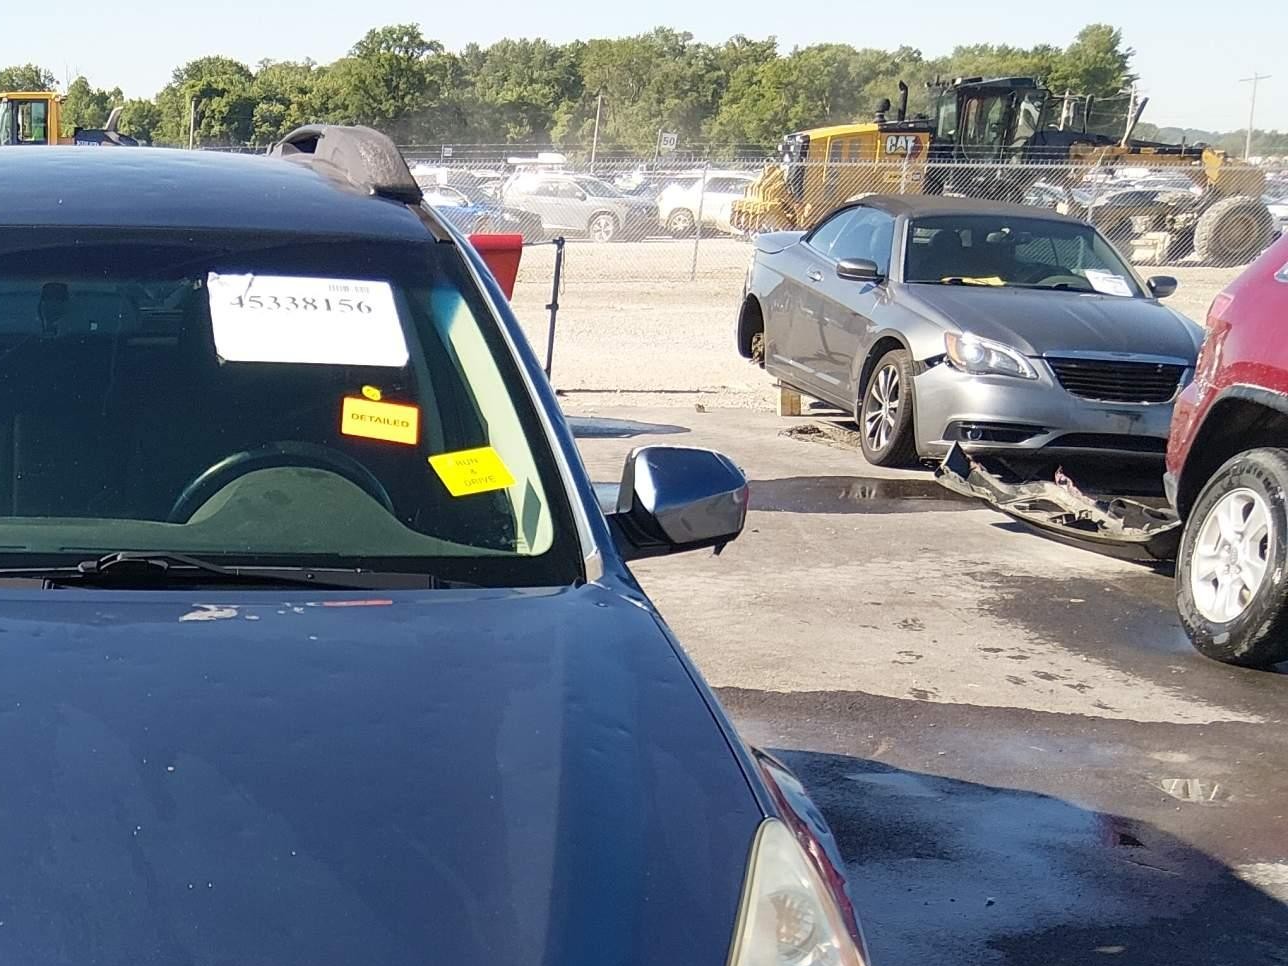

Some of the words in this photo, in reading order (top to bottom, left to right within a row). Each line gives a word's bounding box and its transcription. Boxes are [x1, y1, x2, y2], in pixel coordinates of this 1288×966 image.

[663, 136, 675, 146] 50
[886, 135, 916, 154] CAT
[230, 295, 372, 314] 45338156
[351, 413, 410, 428] DETAILED
[463, 475, 497, 487] DRIVE
